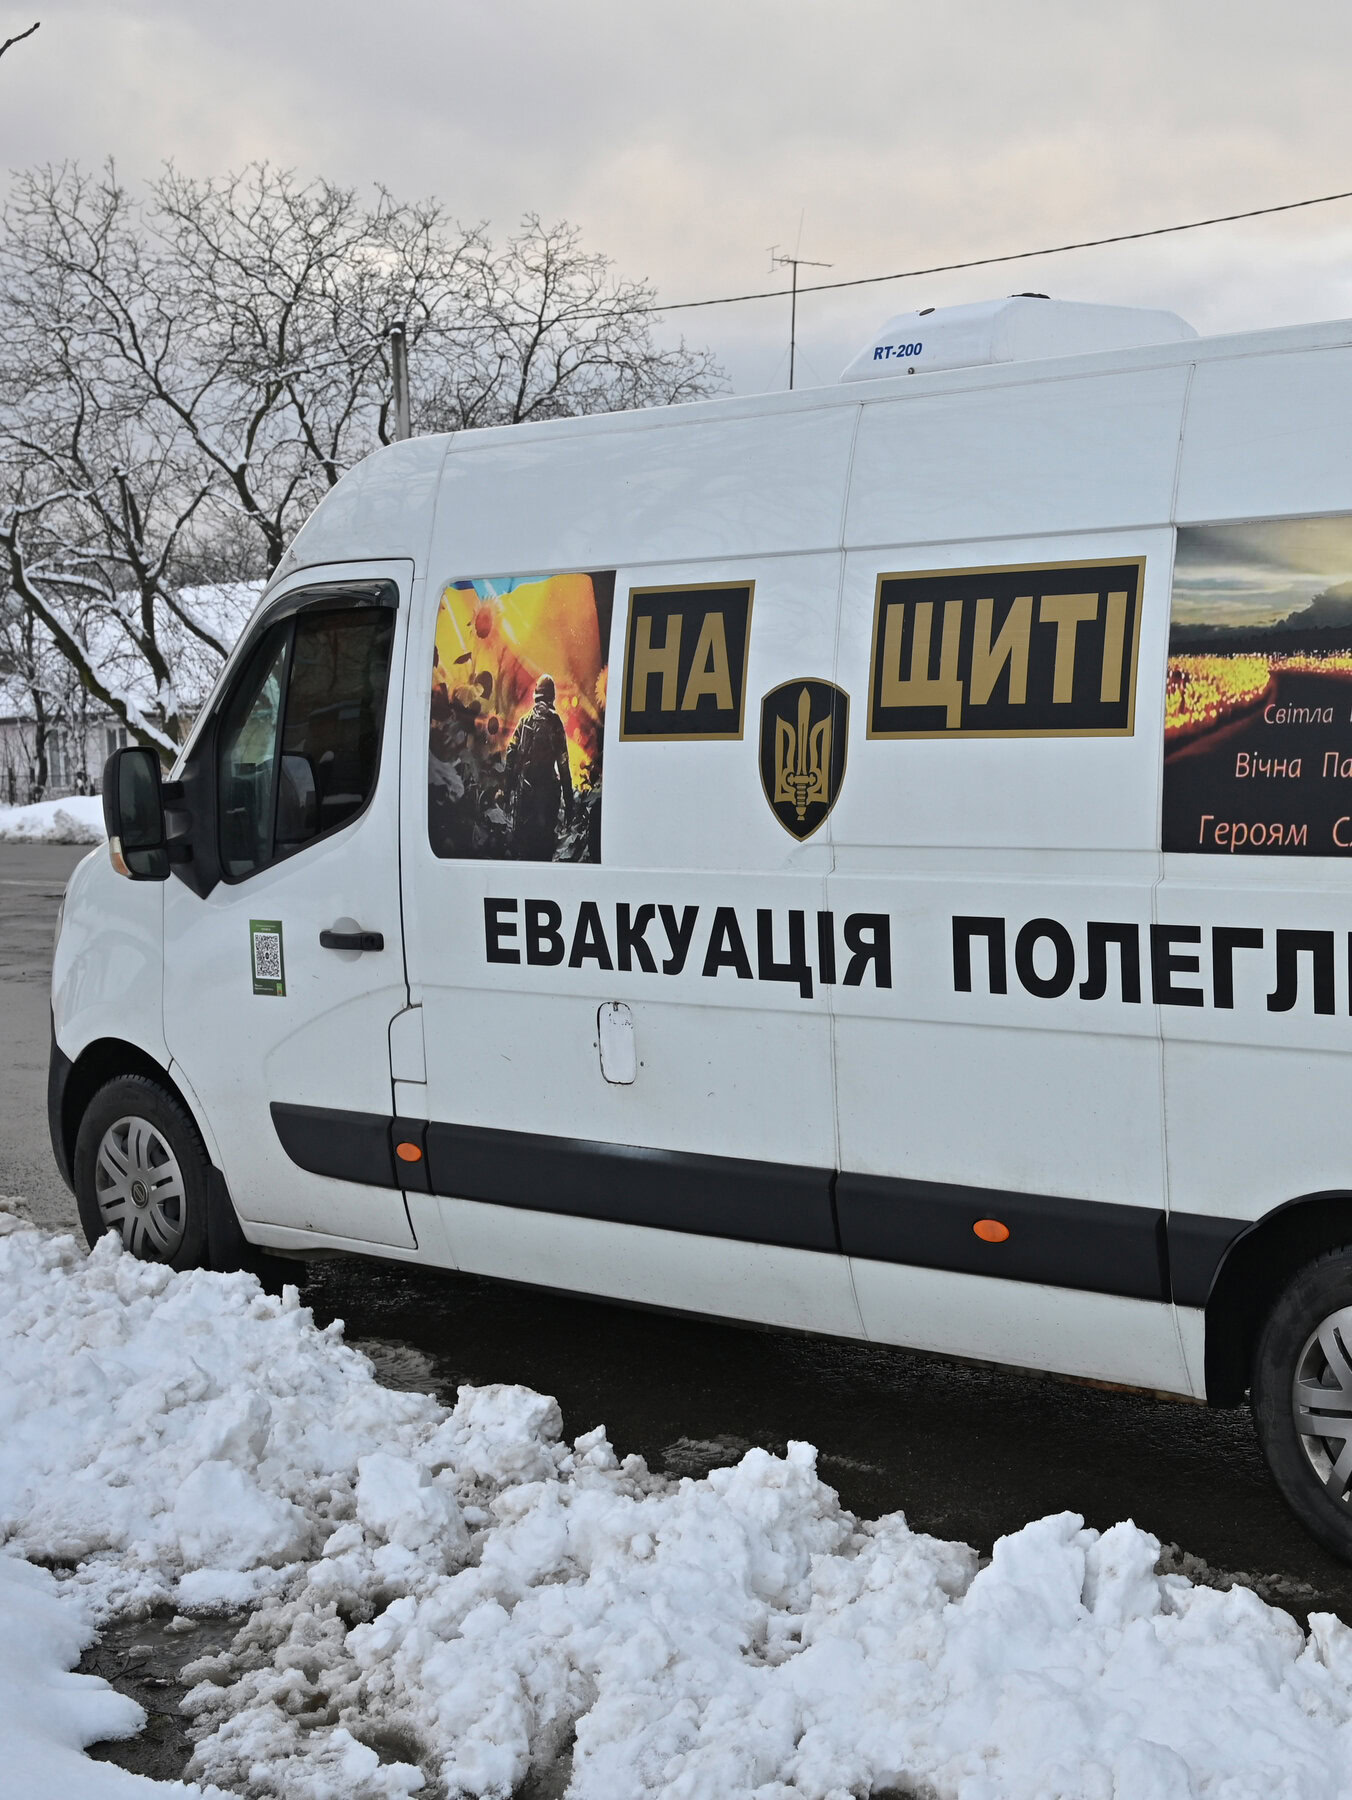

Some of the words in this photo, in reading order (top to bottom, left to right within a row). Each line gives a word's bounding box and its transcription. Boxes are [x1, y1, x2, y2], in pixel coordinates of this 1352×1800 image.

[873, 342, 923, 360] RT-200
[631, 612, 734, 712] НА
[880, 591, 1128, 729] ЩИТІ
[1264, 703, 1334, 725] Світла
[1235, 751, 1302, 778] Вічна
[1199, 815, 1308, 853] Героям
[483, 898, 893, 998] ЕВАКУАЦІЯ
